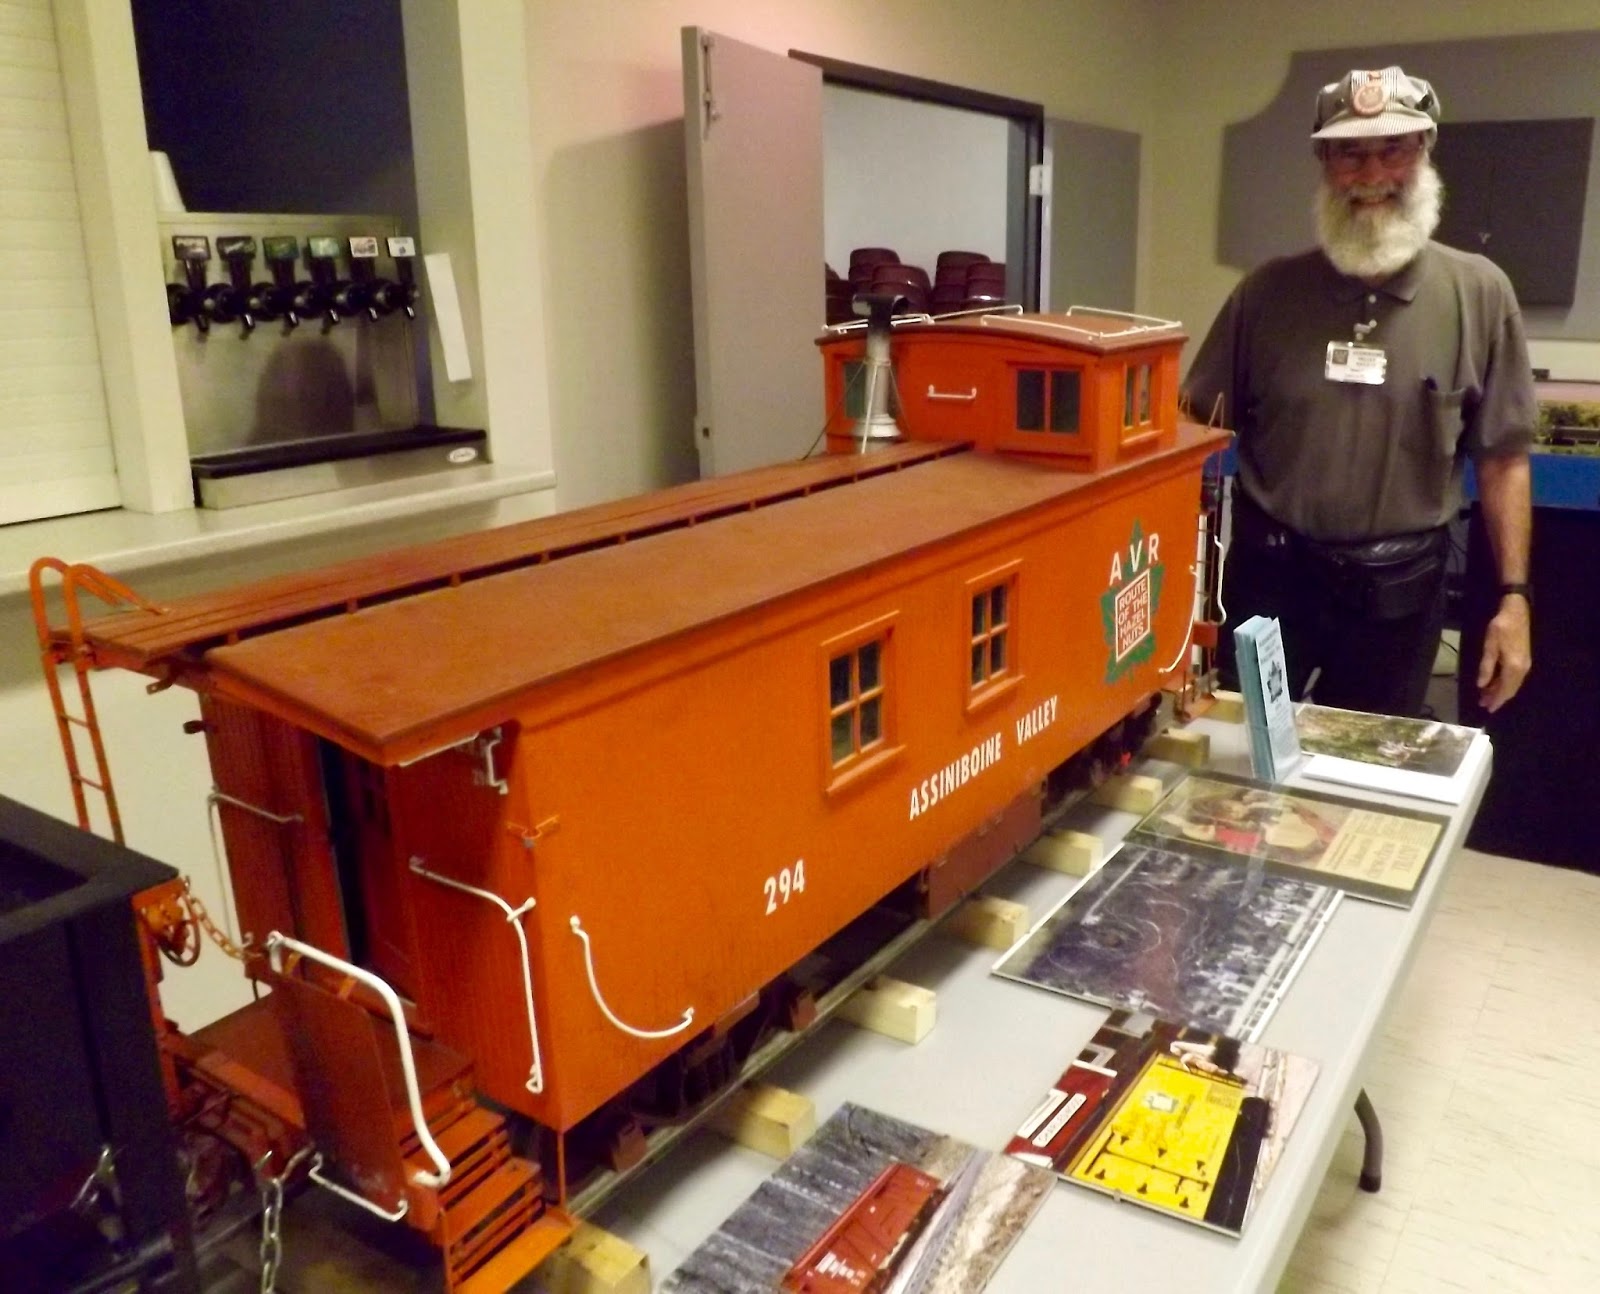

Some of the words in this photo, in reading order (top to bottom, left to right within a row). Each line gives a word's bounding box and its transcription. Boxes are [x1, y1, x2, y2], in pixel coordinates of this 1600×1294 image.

[1118, 606, 1130, 626] OF
[1133, 591, 1148, 612] THE
[1119, 578, 1147, 611] ROUTE
[1120, 607, 1145, 638] HAZEL
[1122, 621, 1144, 650] NUTS
[909, 732, 1002, 821] ASSINIBOINE
[1016, 695, 1058, 746] VALLEY
[763, 858, 805, 916] 294
